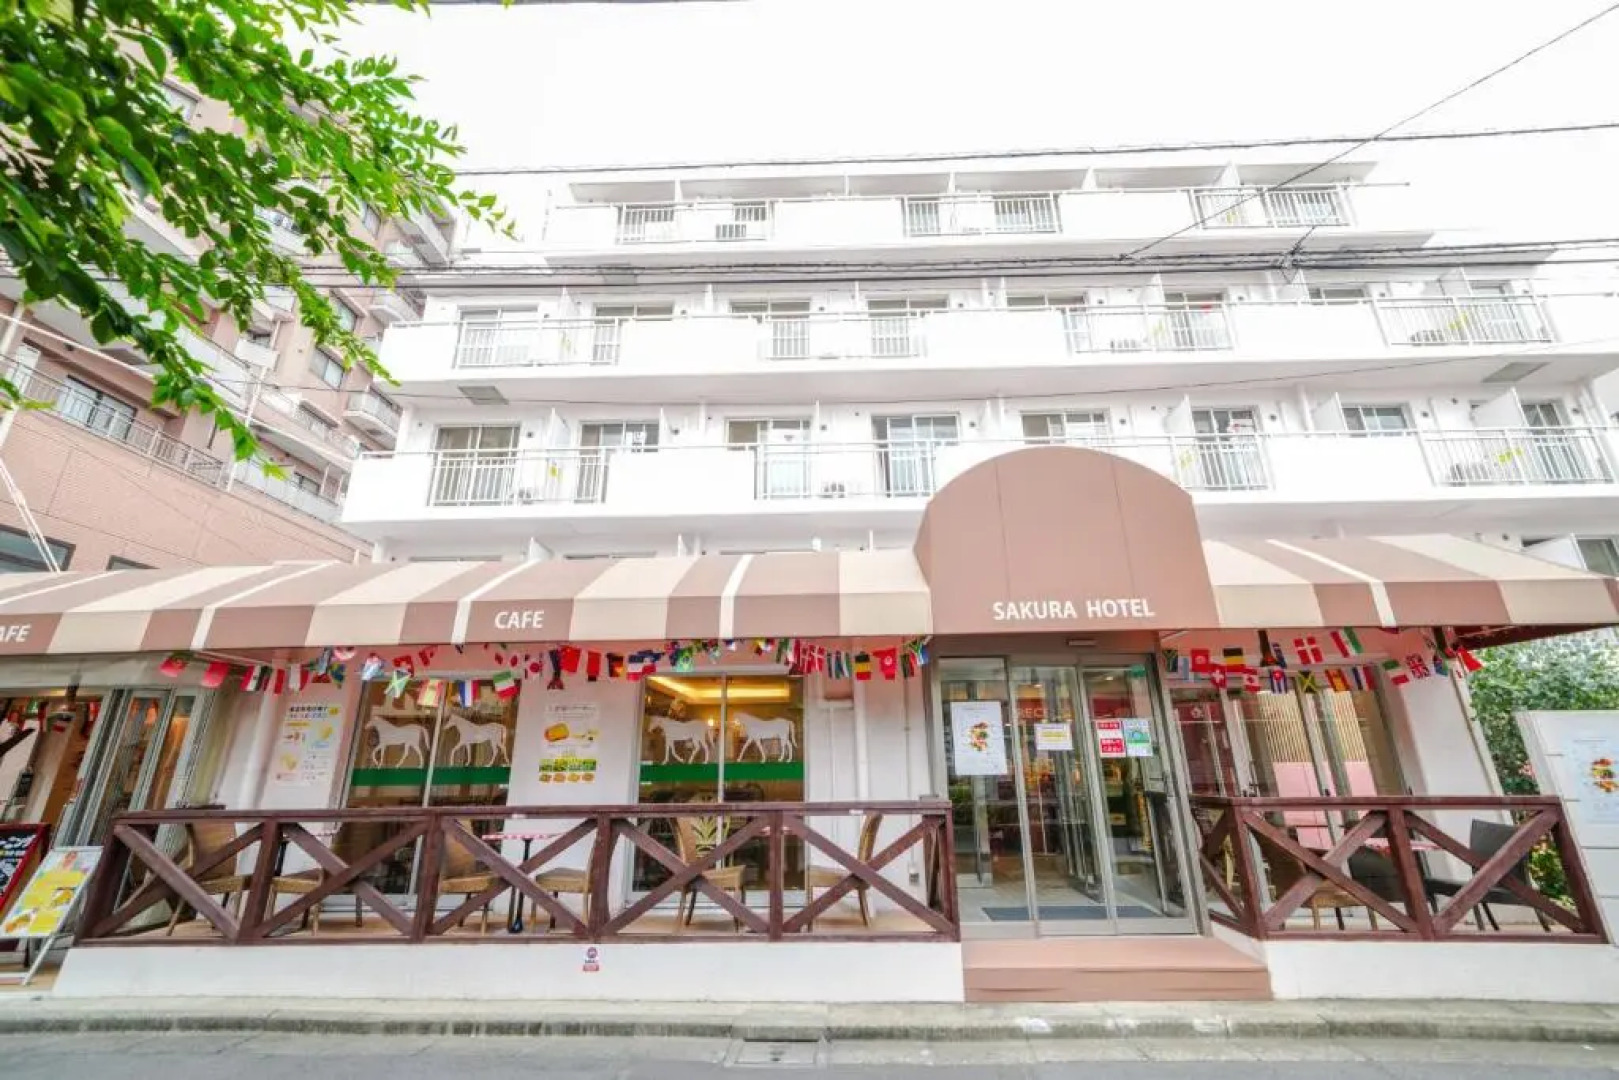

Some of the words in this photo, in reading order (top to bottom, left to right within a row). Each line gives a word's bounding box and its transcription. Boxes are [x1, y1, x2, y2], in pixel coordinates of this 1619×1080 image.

[494, 609, 545, 629] CAFE
[992, 600, 1078, 621] SAKURA
[1086, 598, 1156, 618] HOTEL
